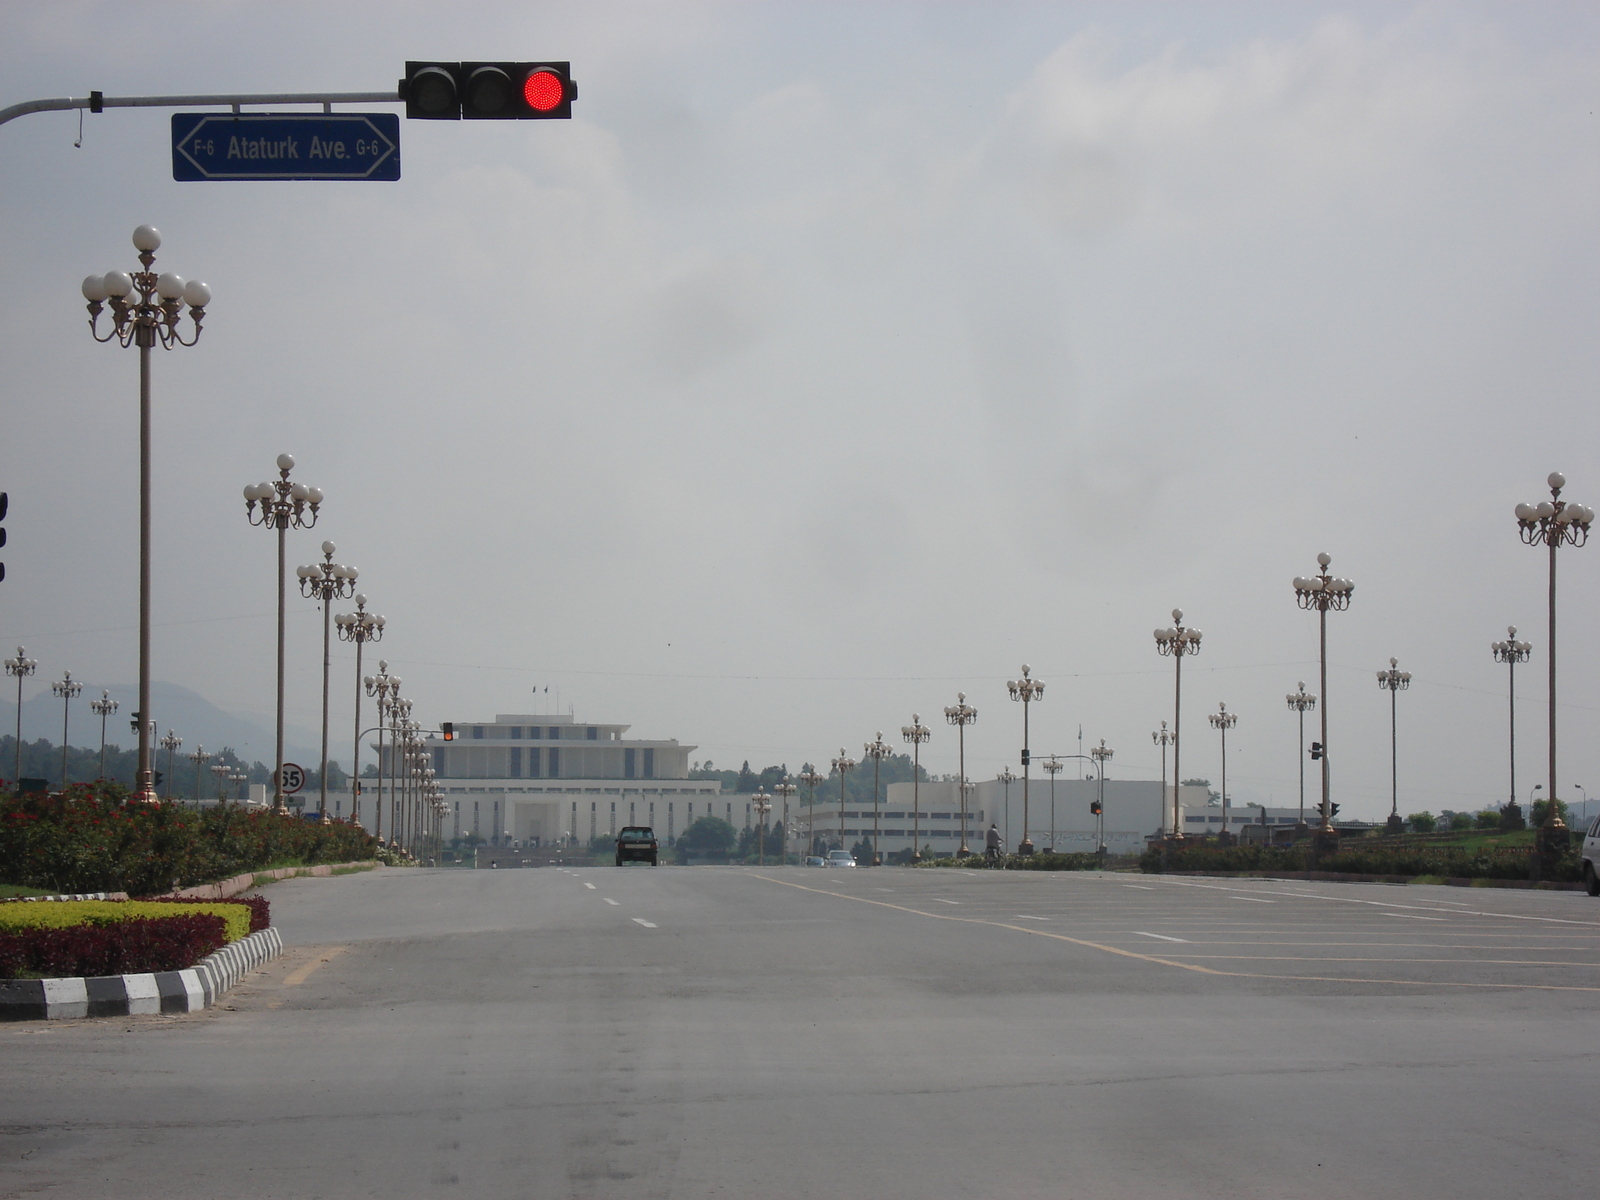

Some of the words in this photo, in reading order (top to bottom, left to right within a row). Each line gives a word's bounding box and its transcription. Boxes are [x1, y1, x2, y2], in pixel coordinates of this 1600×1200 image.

[194, 139, 214, 156] F-6
[227, 135, 299, 159] Ataturk
[309, 135, 351, 159] Ave.
[356, 139, 379, 156] G-6
